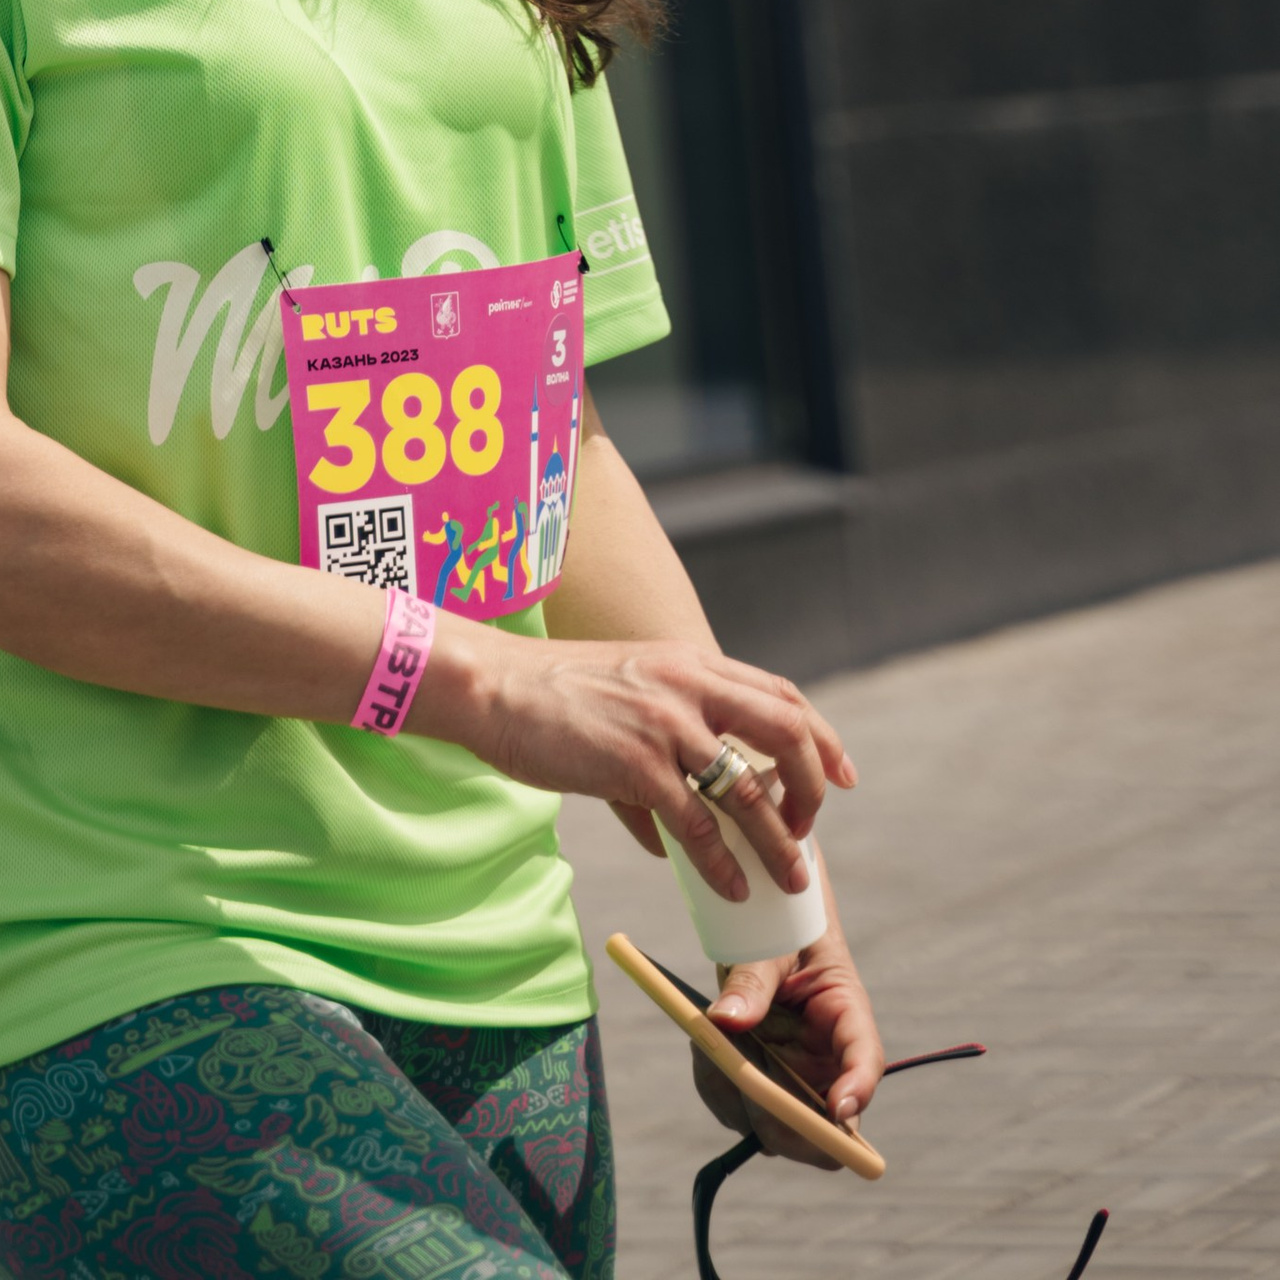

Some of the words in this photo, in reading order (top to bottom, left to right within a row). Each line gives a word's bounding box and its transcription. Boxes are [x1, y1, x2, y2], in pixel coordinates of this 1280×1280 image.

[300, 306, 398, 341] RUTS
[307, 353, 378, 371] КАЗАНЬ
[380, 348, 419, 364] 2023
[551, 329, 567, 368] 3
[545, 371, 570, 386] ВОЛНА
[306, 364, 505, 494] 388
